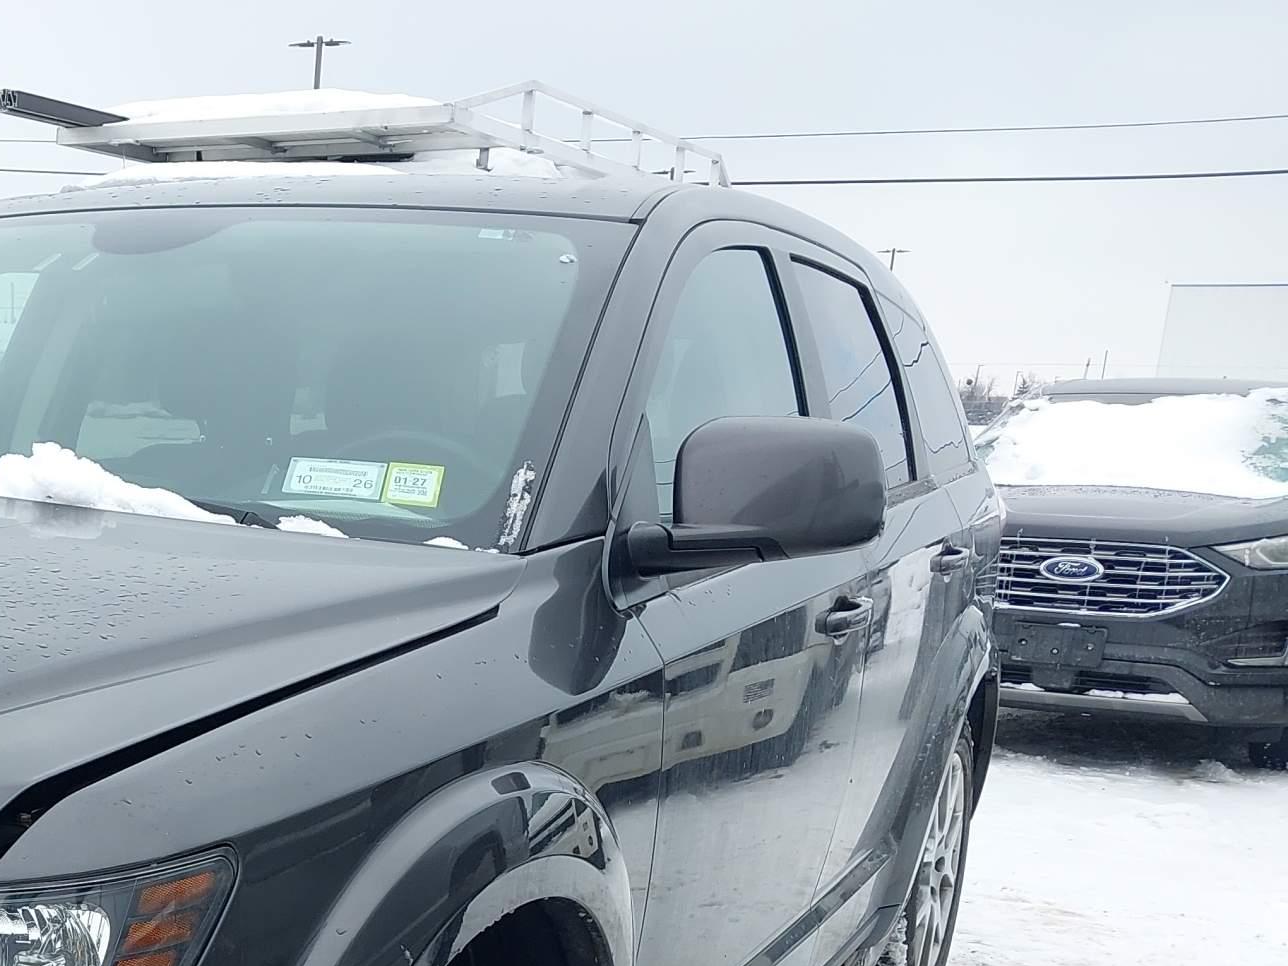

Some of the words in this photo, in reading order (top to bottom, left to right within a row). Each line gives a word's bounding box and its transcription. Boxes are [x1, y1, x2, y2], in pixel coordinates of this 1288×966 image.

[296, 475, 313, 485] 10
[352, 479, 374, 489] 26
[1054, 562, 1088, 575] Ford
